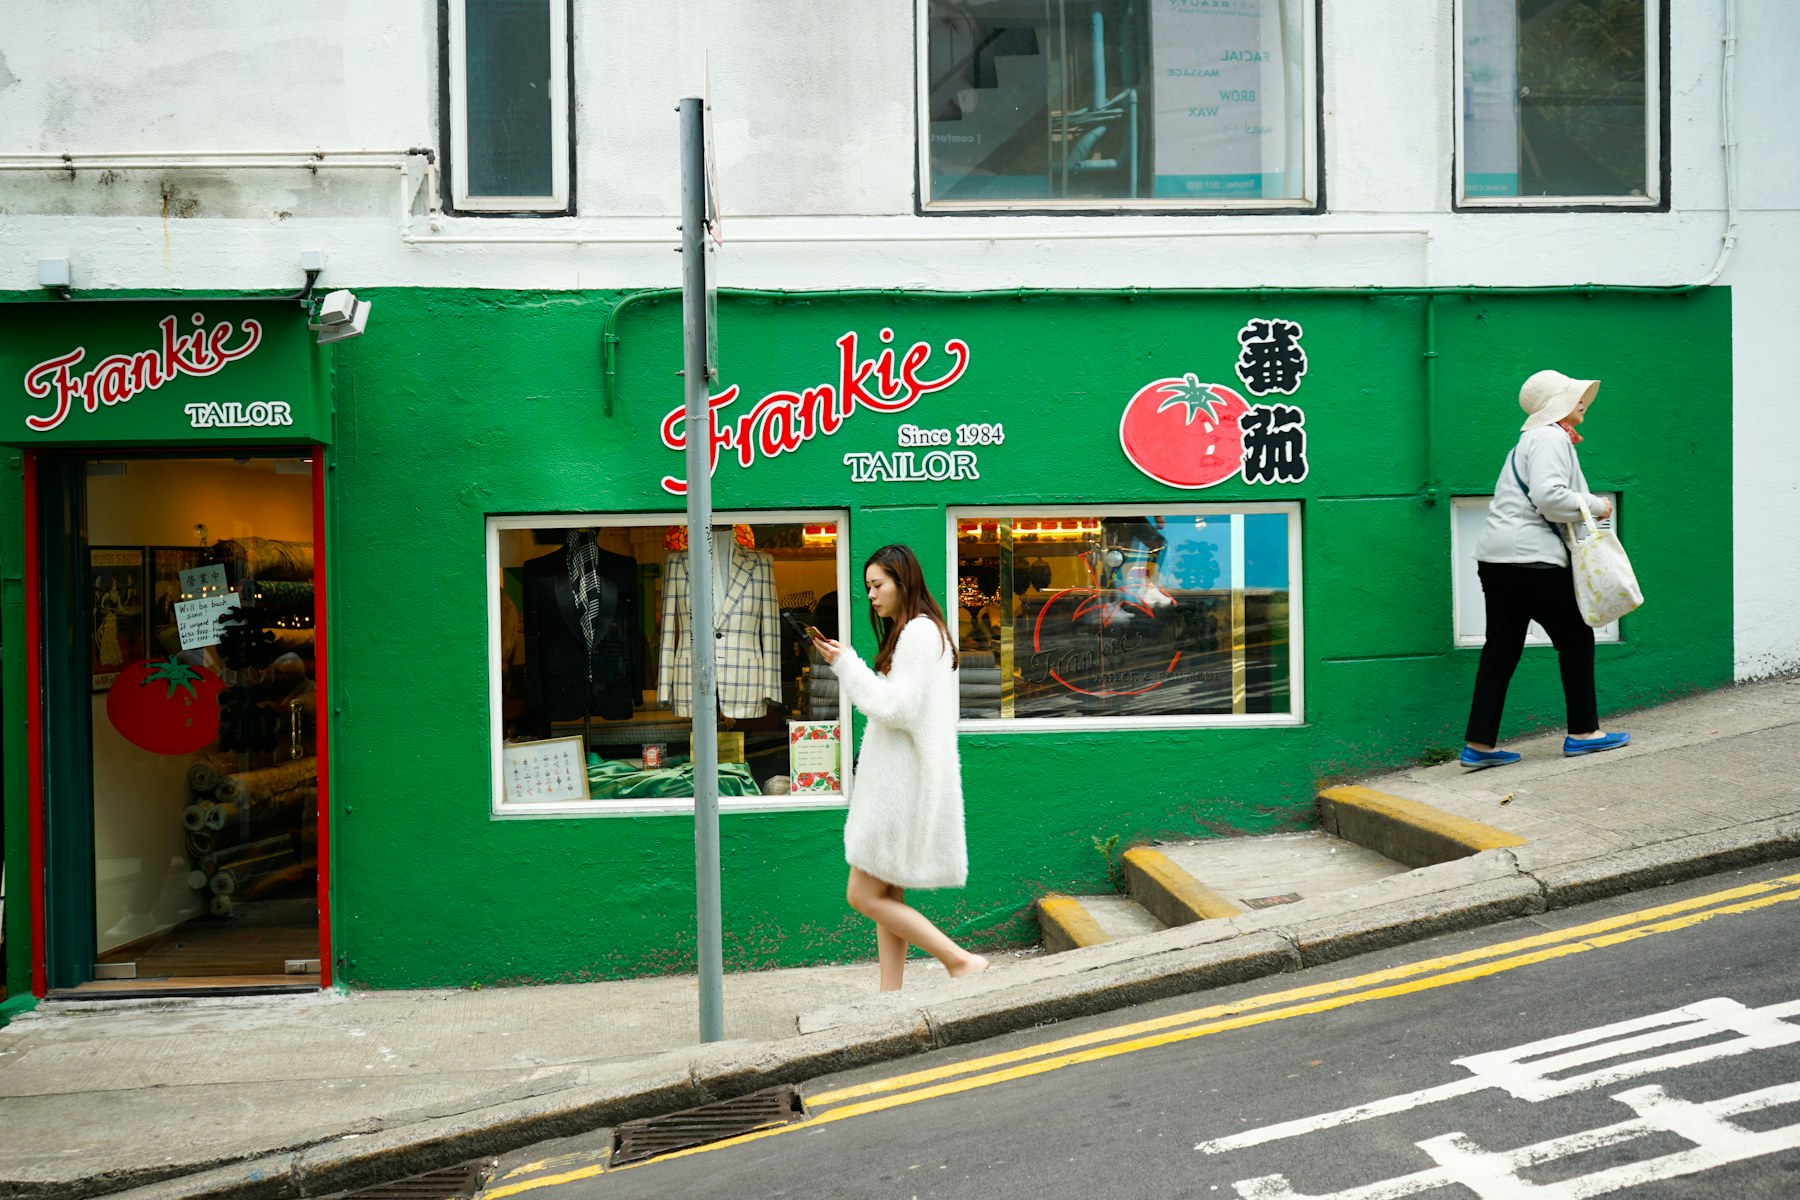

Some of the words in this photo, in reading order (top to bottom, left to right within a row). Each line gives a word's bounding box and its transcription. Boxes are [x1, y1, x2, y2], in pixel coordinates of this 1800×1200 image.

[25, 312, 262, 431] Frankie
[185, 401, 293, 428] TAILOR
[661, 328, 970, 495] Frankie
[899, 425, 950, 446] Since
[957, 423, 1004, 445] 1984
[844, 451, 979, 482] TAILOR
[179, 604, 195, 613] Will
[199, 601, 208, 610] be
[212, 599, 228, 608] back
[180, 623, 186, 631] If
[190, 619, 209, 631] urgent
[1028, 628, 1144, 684] Frankie
